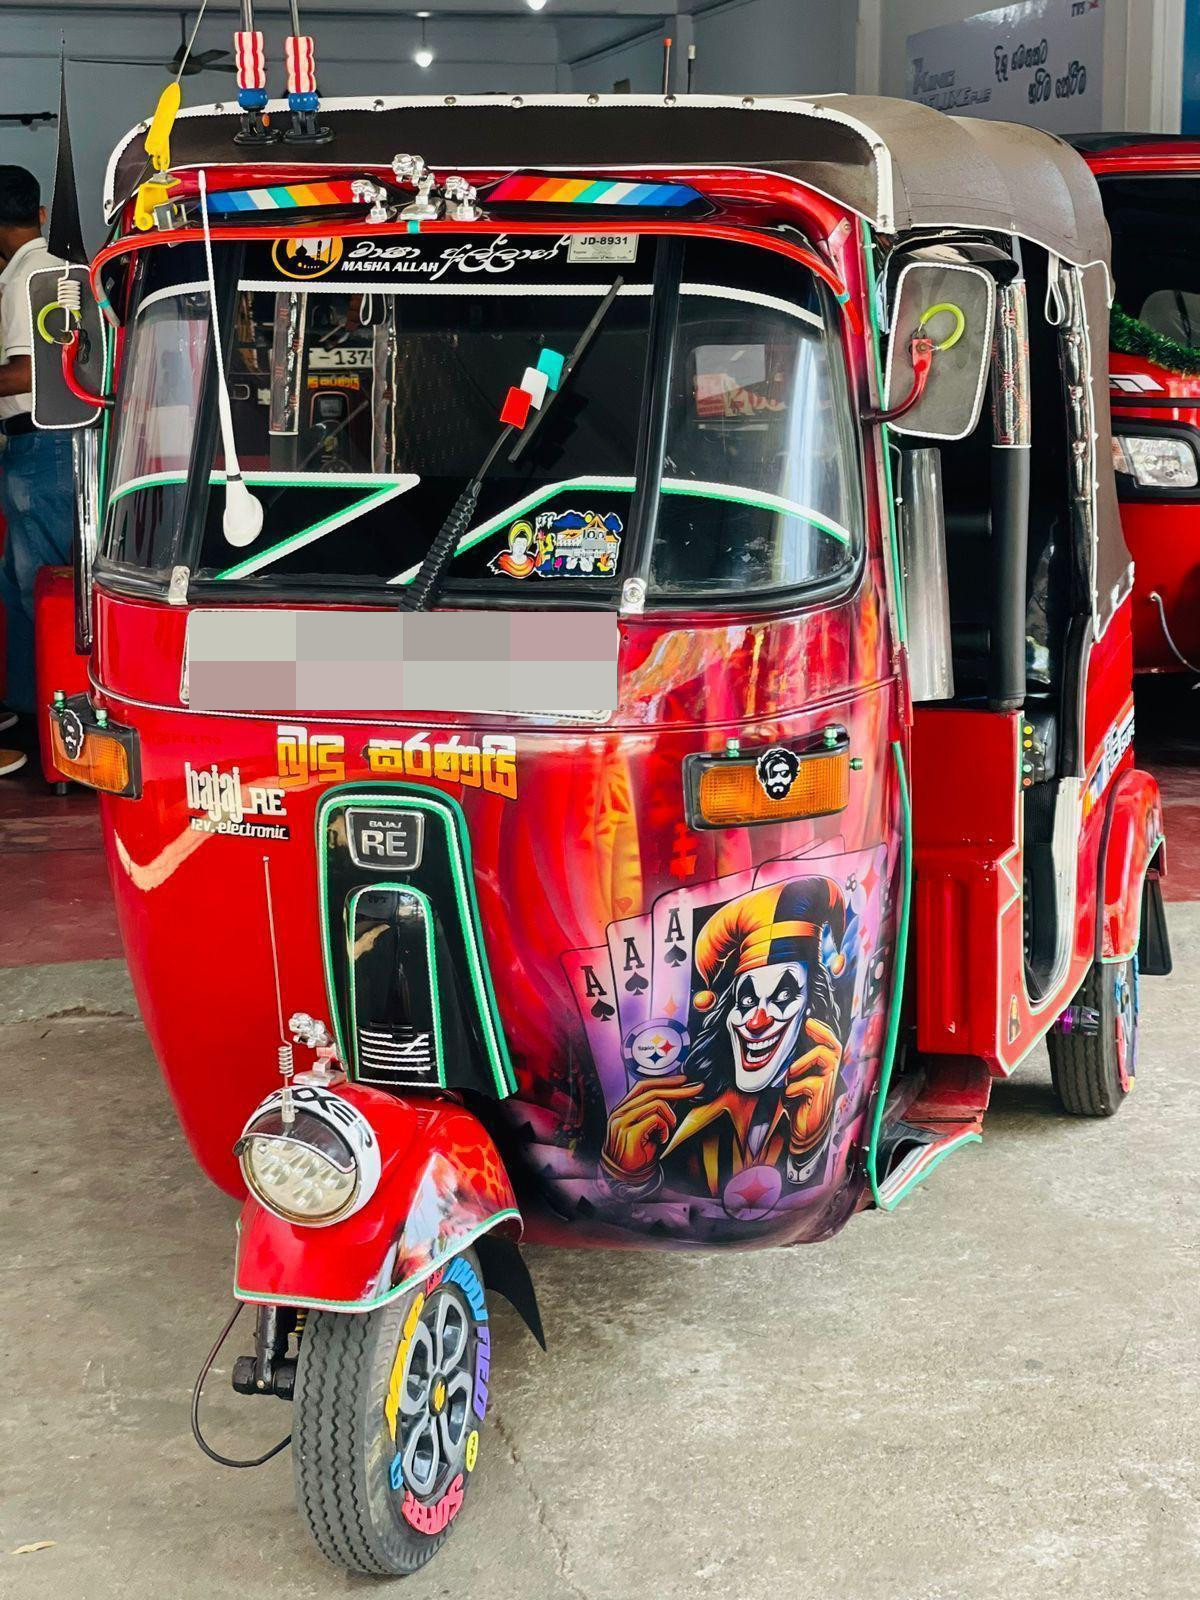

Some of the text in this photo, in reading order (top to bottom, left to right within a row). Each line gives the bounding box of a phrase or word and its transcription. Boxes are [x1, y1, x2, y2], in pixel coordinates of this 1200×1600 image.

[580, 236, 628, 246] JD-8931
[341, 261, 440, 273] MASHA ALLAH
[184, 761, 287, 824] bajaj RE
[369, 820, 402, 829] BAJAJ
[361, 829, 408, 857] RE
[663, 907, 686, 943] A
[622, 936, 646, 972] A
[579, 965, 608, 998] A
